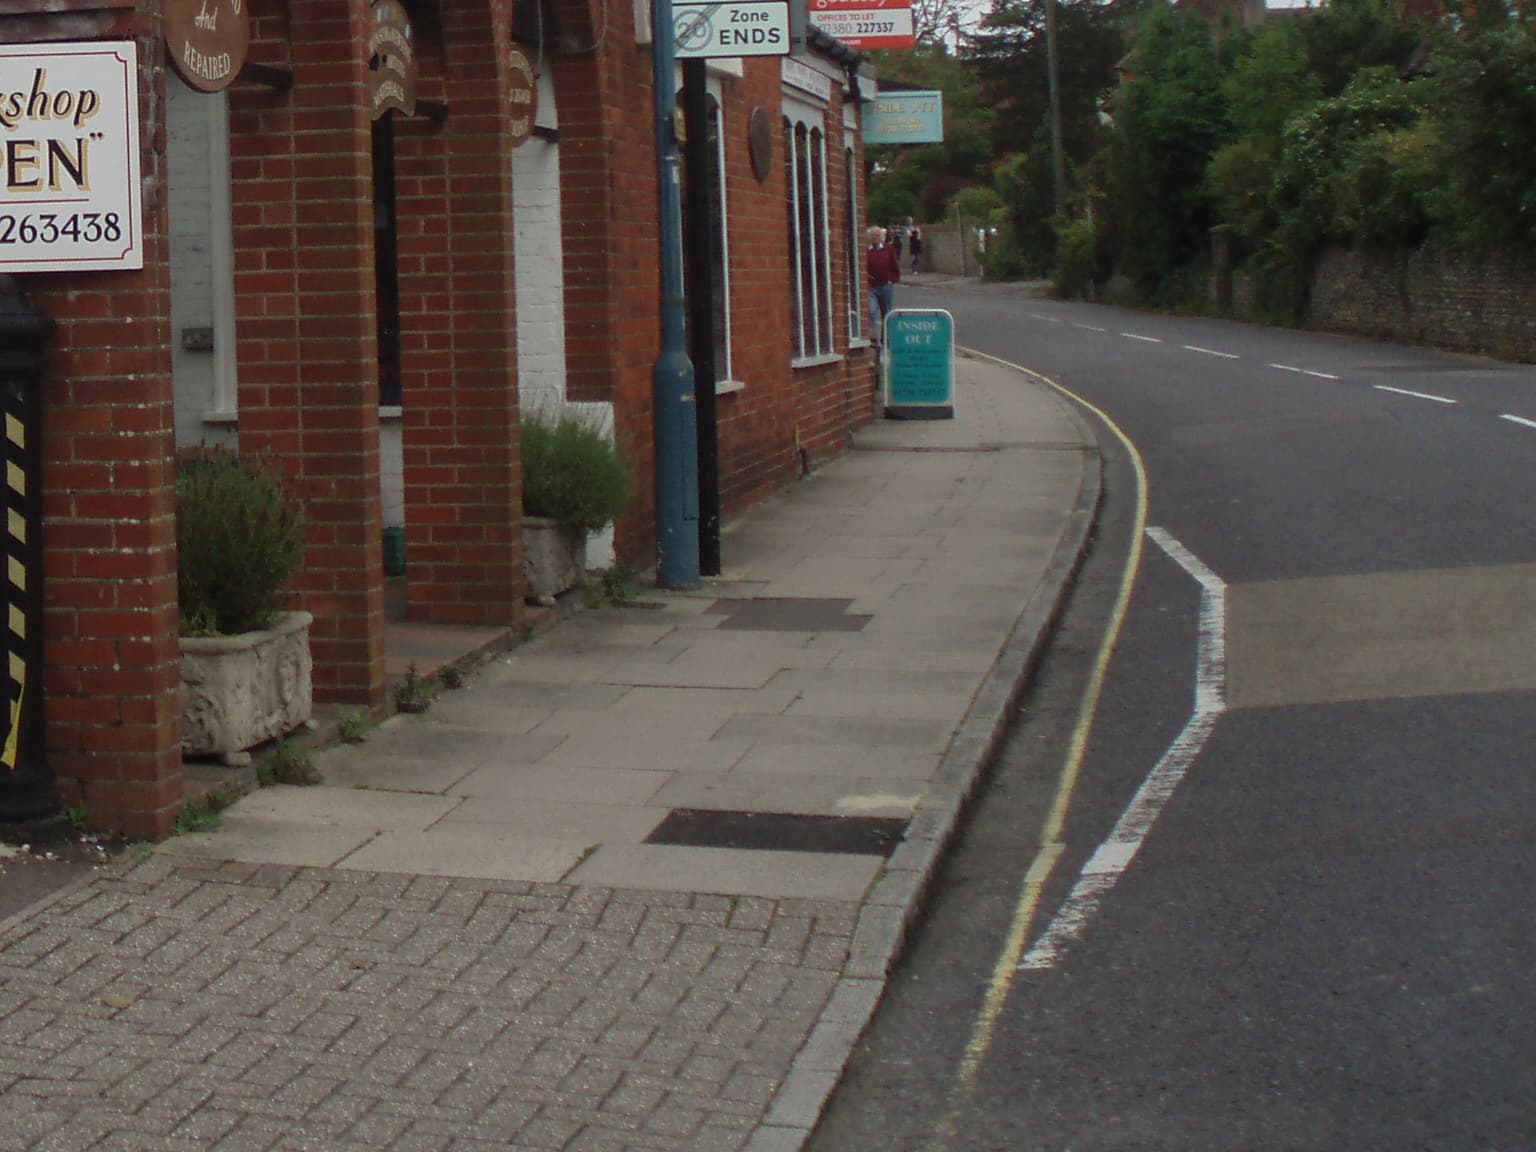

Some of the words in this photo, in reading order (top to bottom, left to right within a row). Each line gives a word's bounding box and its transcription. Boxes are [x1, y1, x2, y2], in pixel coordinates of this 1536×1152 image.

[195, 0, 218, 32] And
[730, 9, 769, 23] Zone
[719, 27, 781, 46] ENDS
[856, 22, 895, 33] 227337
[183, 40, 231, 81] REPAIRED
